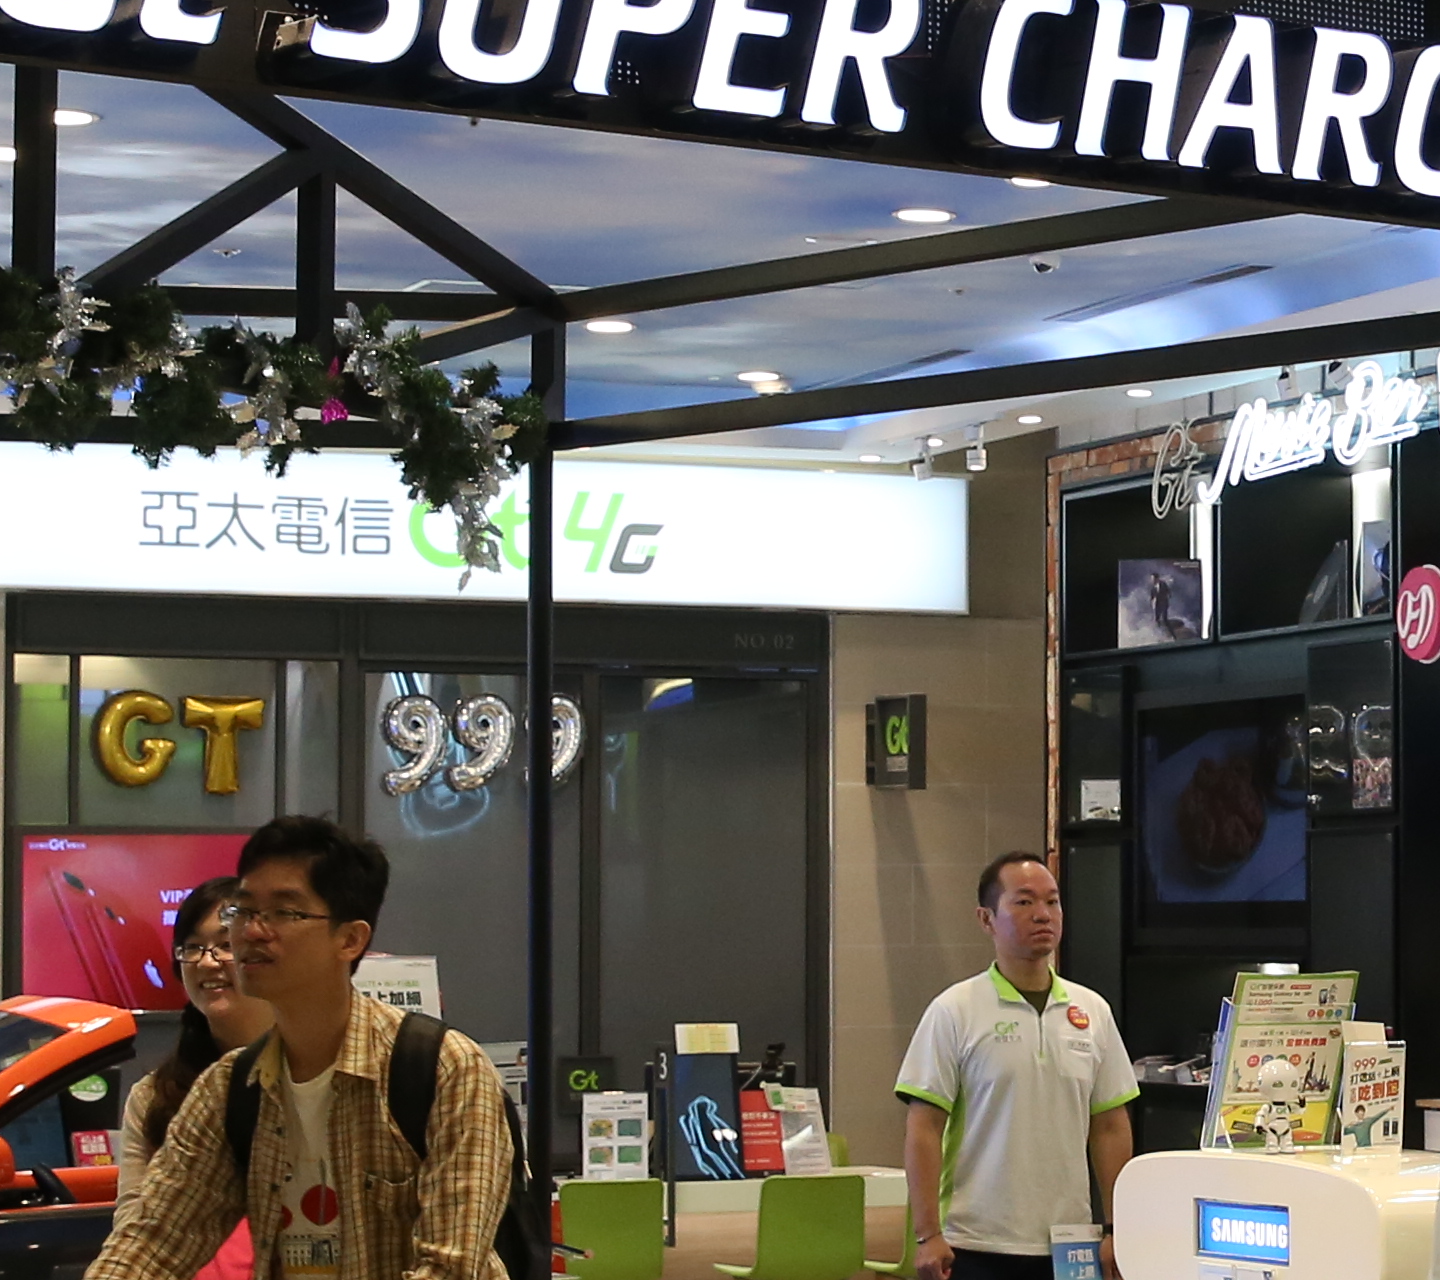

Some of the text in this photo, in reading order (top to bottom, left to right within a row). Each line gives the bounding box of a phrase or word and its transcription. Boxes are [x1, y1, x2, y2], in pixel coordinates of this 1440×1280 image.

[138, 489, 395, 556] 亞太電信
[92, 688, 265, 795] GT
[568, 1069, 599, 1091] Gt
[1354, 1057, 1377, 1071] 999
[1211, 1217, 1288, 1249] SAMSUNG
